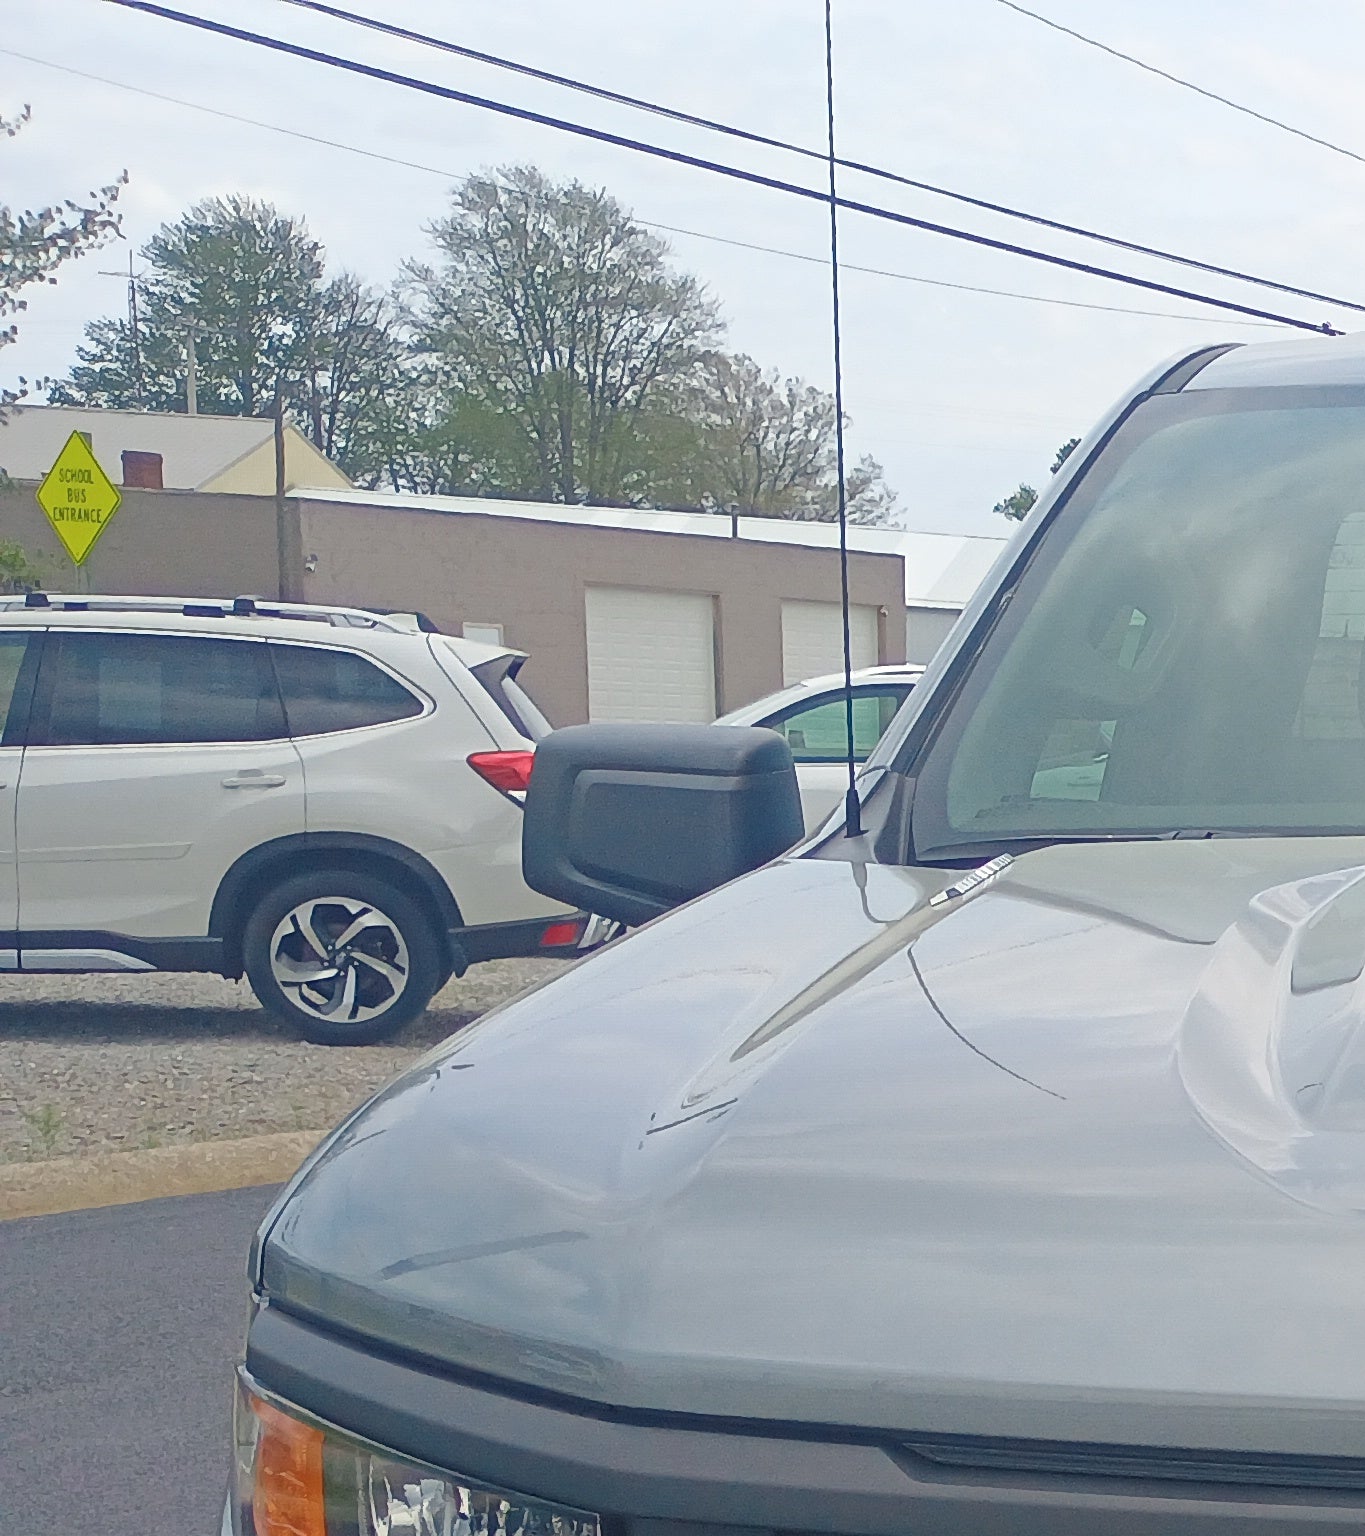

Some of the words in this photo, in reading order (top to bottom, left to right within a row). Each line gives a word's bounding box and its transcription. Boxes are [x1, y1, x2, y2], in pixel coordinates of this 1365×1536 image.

[59, 468, 94, 484] SCHOOL
[67, 488, 87, 503] BUS
[53, 507, 102, 523] ENTRANCE
